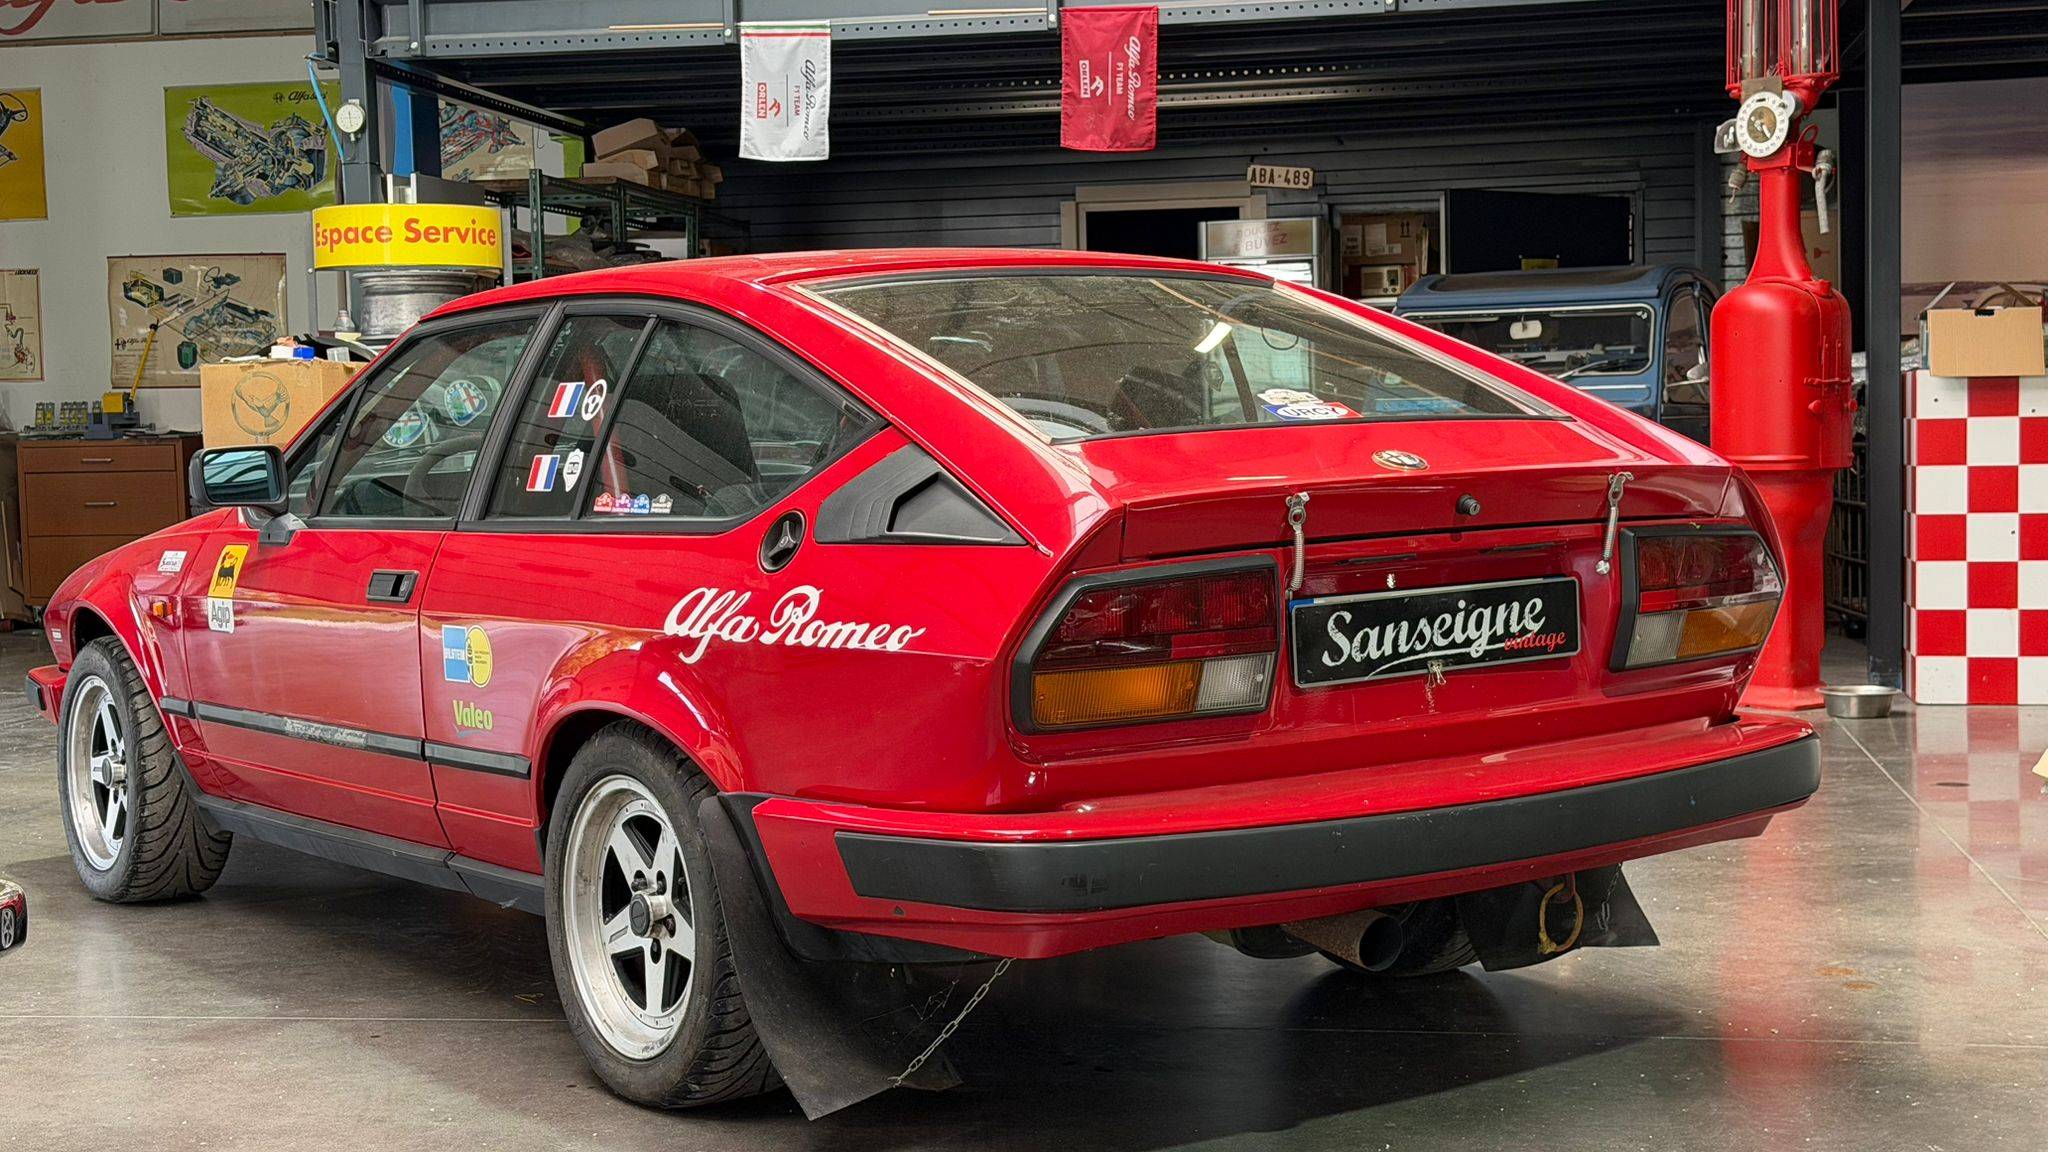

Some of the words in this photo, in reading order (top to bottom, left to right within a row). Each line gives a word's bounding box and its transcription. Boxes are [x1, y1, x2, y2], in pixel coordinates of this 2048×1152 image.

[1117, 62, 1124, 71] F1
[1123, 36, 1141, 69] Alfa
[794, 84, 801, 94] F1
[800, 59, 816, 91] Alfa
[1080, 61, 1090, 97] ORLEN
[1116, 73, 1124, 95] TEAM
[288, 90, 328, 104] Alfasd
[758, 83, 767, 118] ORLEN
[793, 95, 801, 116] TEAM
[1127, 70, 1141, 121] Romeo
[803, 92, 817, 141] Romeo
[1250, 167, 1310, 186] ABA-489
[315, 222, 393, 253] Espace
[404, 217, 497, 246] Service
[1245, 233, 1288, 252] BUVEZ
[211, 600, 231, 629] Agip
[663, 587, 760, 664] Alfa
[758, 585, 927, 652] Romeo
[1322, 597, 1546, 667] Sanseigne
[1503, 630, 1567, 651] vintage
[453, 699, 493, 730] Valeo
